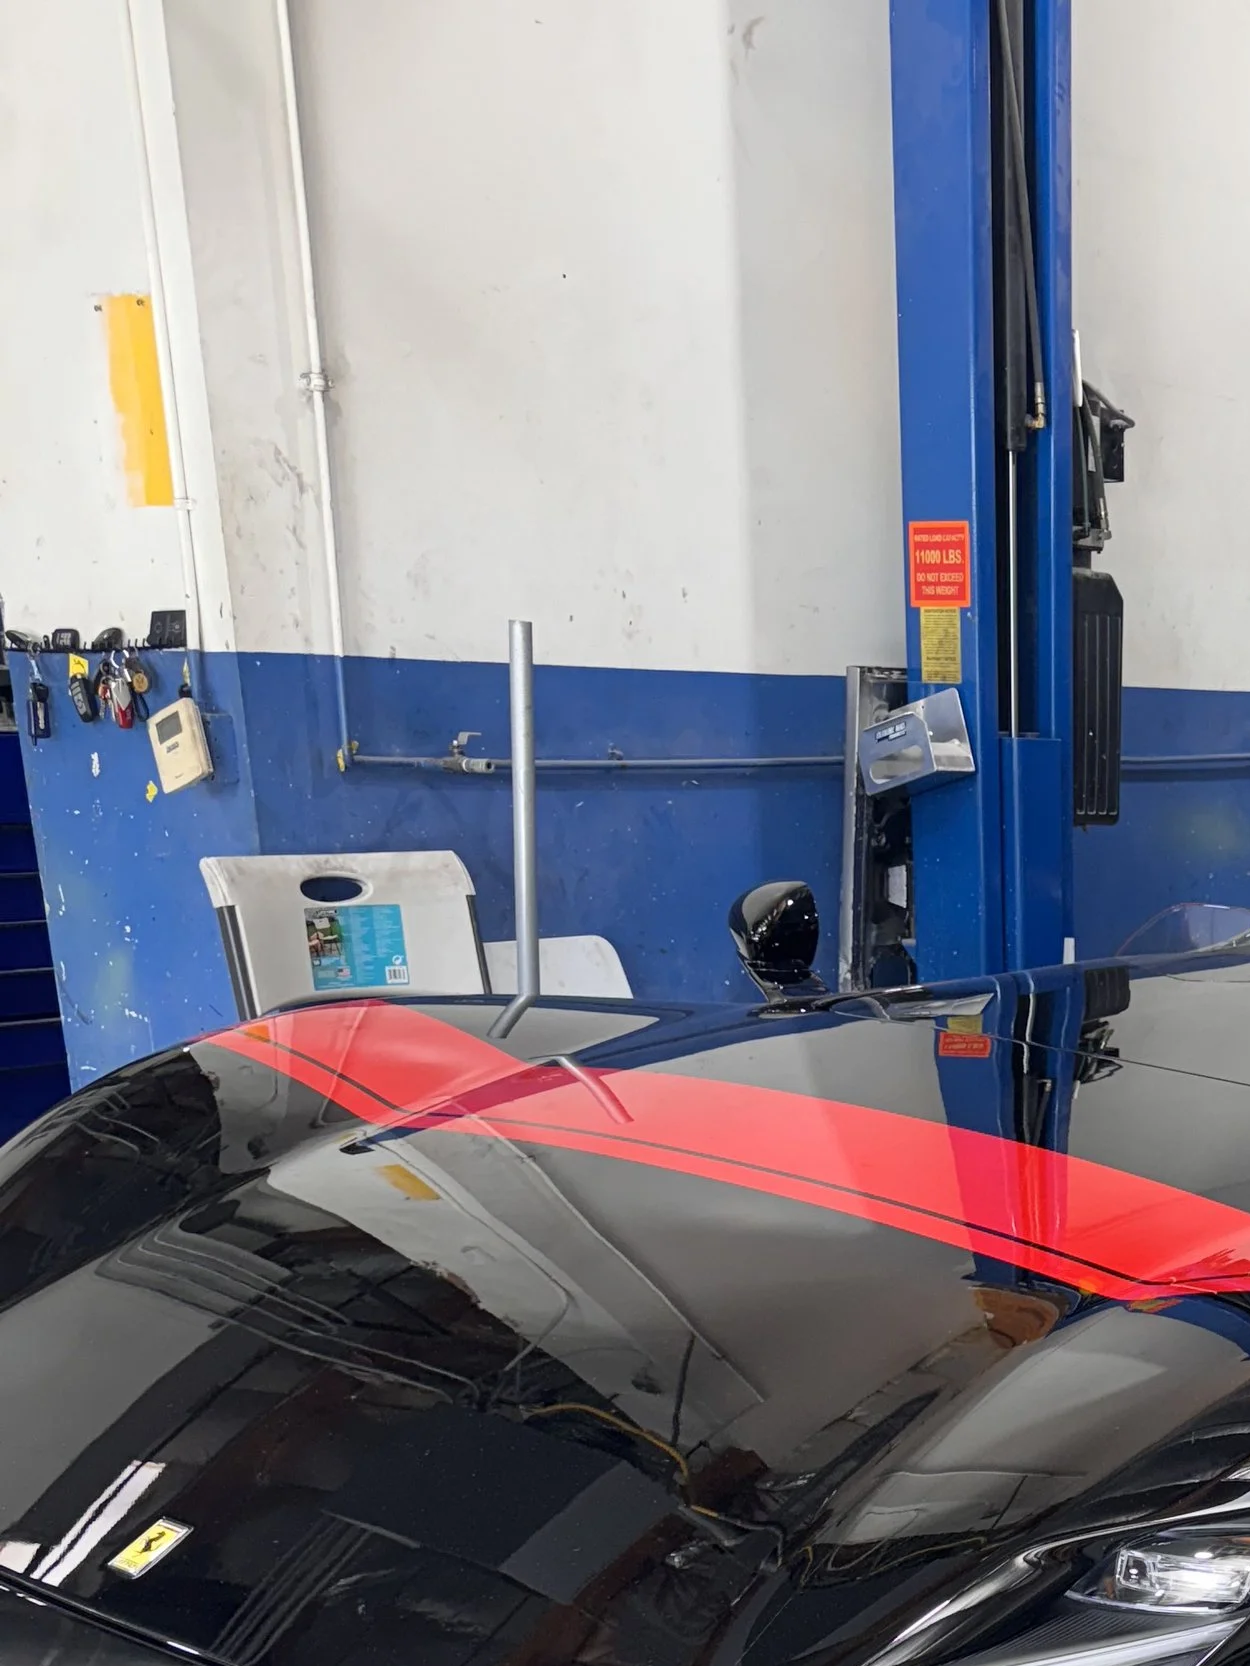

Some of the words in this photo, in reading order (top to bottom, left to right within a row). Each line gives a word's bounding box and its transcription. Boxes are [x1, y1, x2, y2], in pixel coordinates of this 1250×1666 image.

[915, 549, 941, 564] 11000
[942, 549, 965, 564] LBS.
[916, 572, 926, 582] DO
[926, 572, 939, 582] NOT
